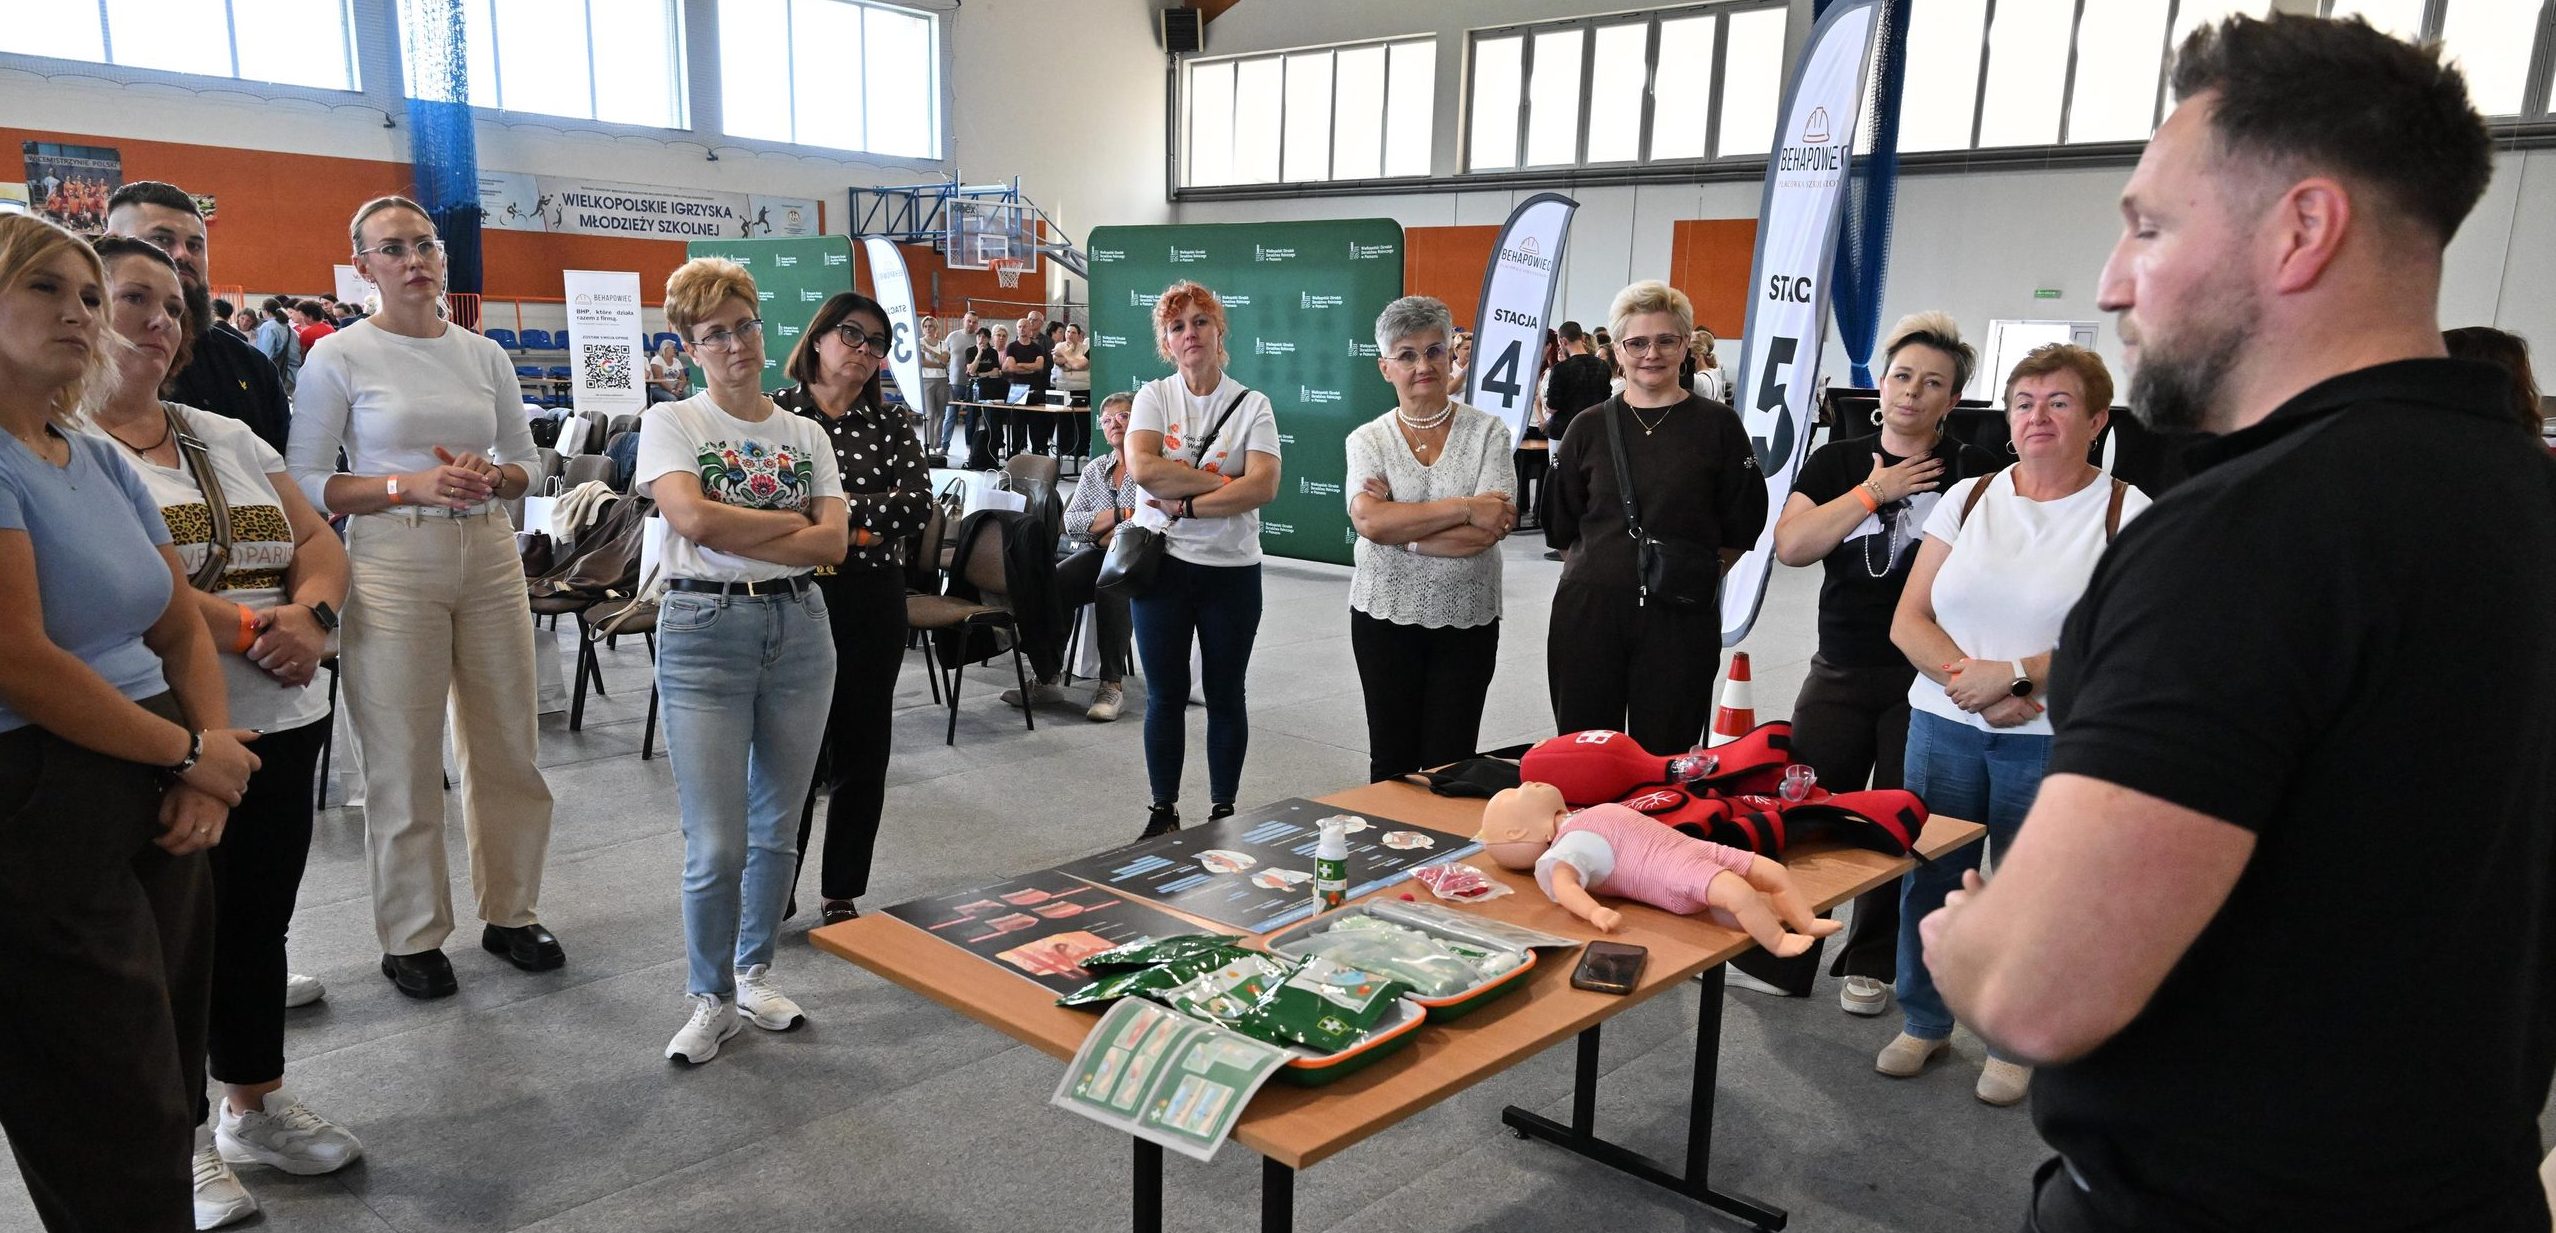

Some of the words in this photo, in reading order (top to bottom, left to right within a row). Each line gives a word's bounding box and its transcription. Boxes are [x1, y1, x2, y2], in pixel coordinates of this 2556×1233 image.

[562, 192, 667, 214] WIELKOPOLSKIE
[671, 202, 733, 219] IGRZYSKA
[579, 213, 655, 233] MŁODZIEŻY
[658, 217, 720, 237] SZKOLNEJ
[1501, 248, 1552, 272] BEHAPOWIEC
[593, 294, 632, 303] BEHAPOWIEC
[1494, 308, 1538, 329] STACJA
[1481, 339, 1523, 409] 4
[1751, 336, 1798, 479] 5
